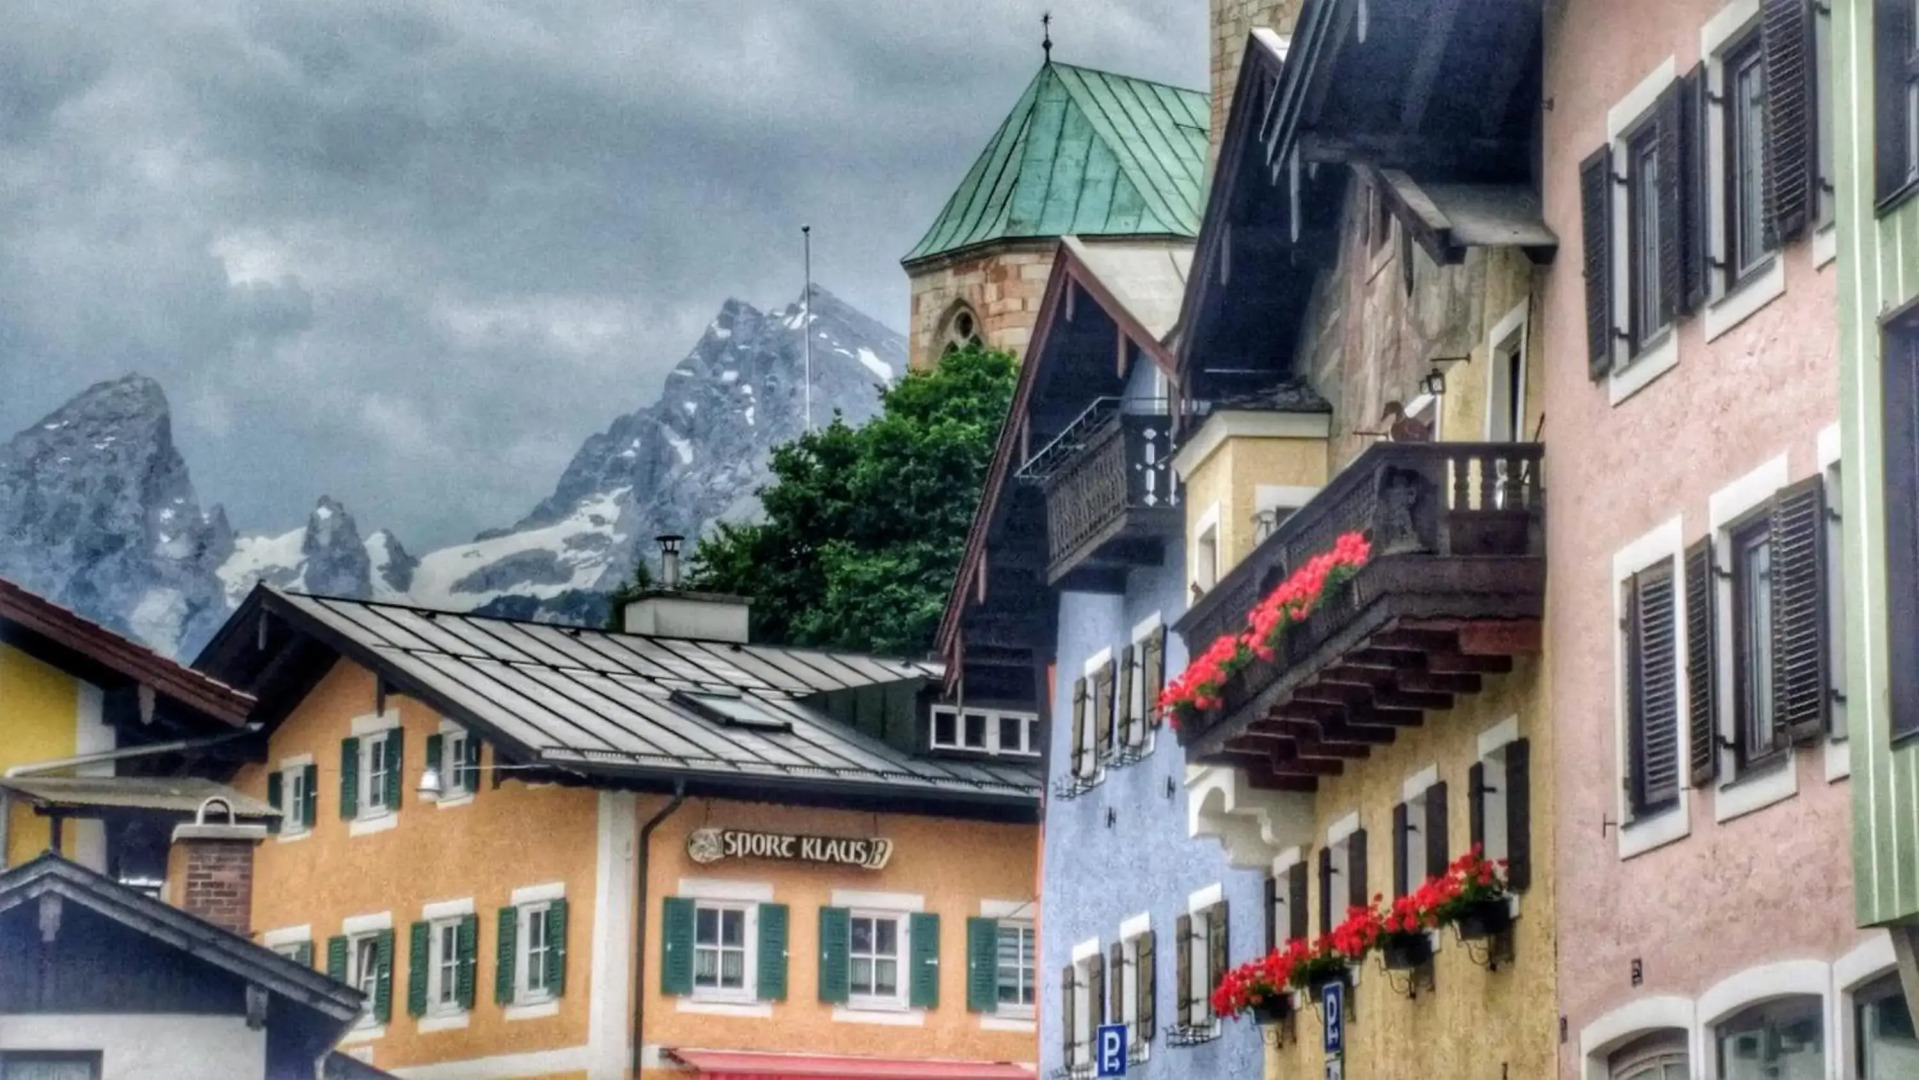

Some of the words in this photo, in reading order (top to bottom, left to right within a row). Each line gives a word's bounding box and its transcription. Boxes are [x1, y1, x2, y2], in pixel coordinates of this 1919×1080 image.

[724, 831, 796, 858] SPORT
[801, 838, 867, 864] KLAUS
[1327, 993, 1338, 1045] P
[1104, 1031, 1120, 1072] P
